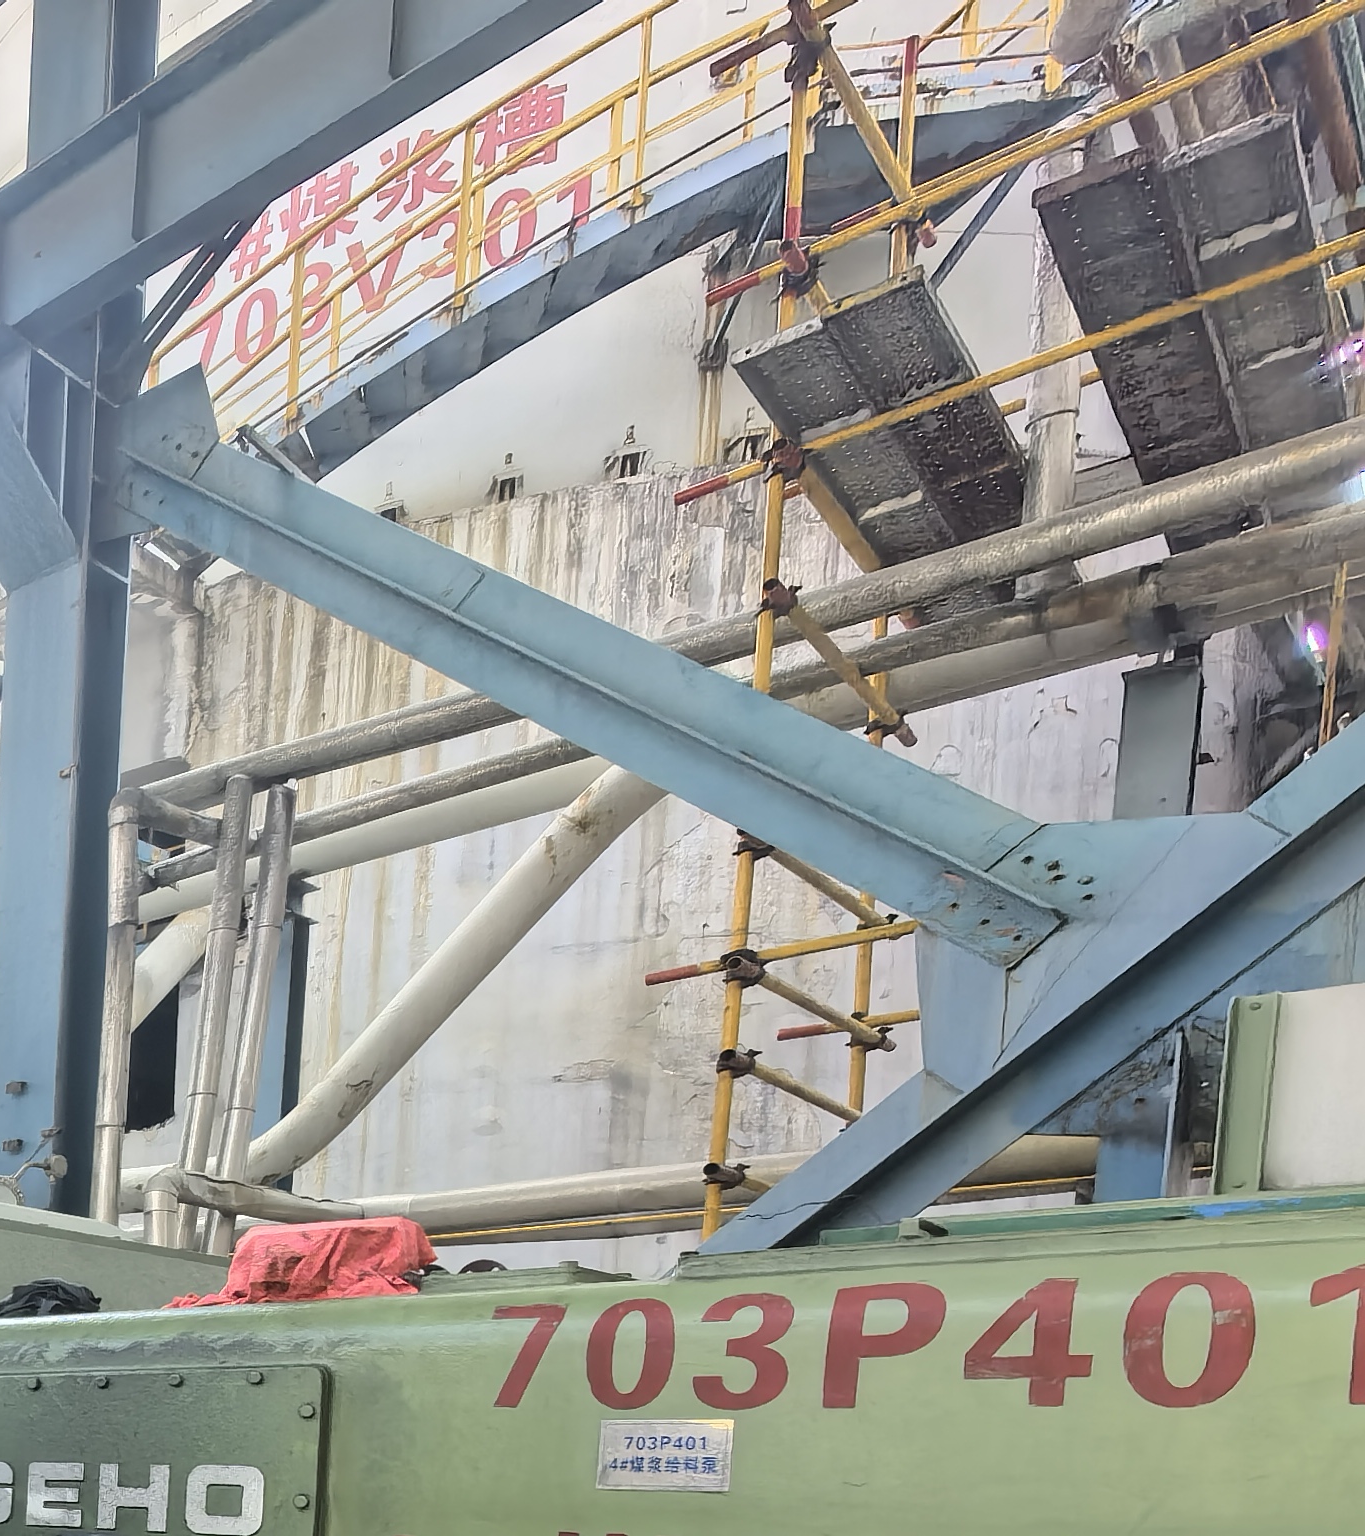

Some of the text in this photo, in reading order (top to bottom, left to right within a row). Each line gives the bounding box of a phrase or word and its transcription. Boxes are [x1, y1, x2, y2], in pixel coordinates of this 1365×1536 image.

[491, 1263, 1365, 1411] 703P401
[623, 1435, 708, 1451] 703P401
[609, 1455, 719, 1474] 4#煤浆给料泵
